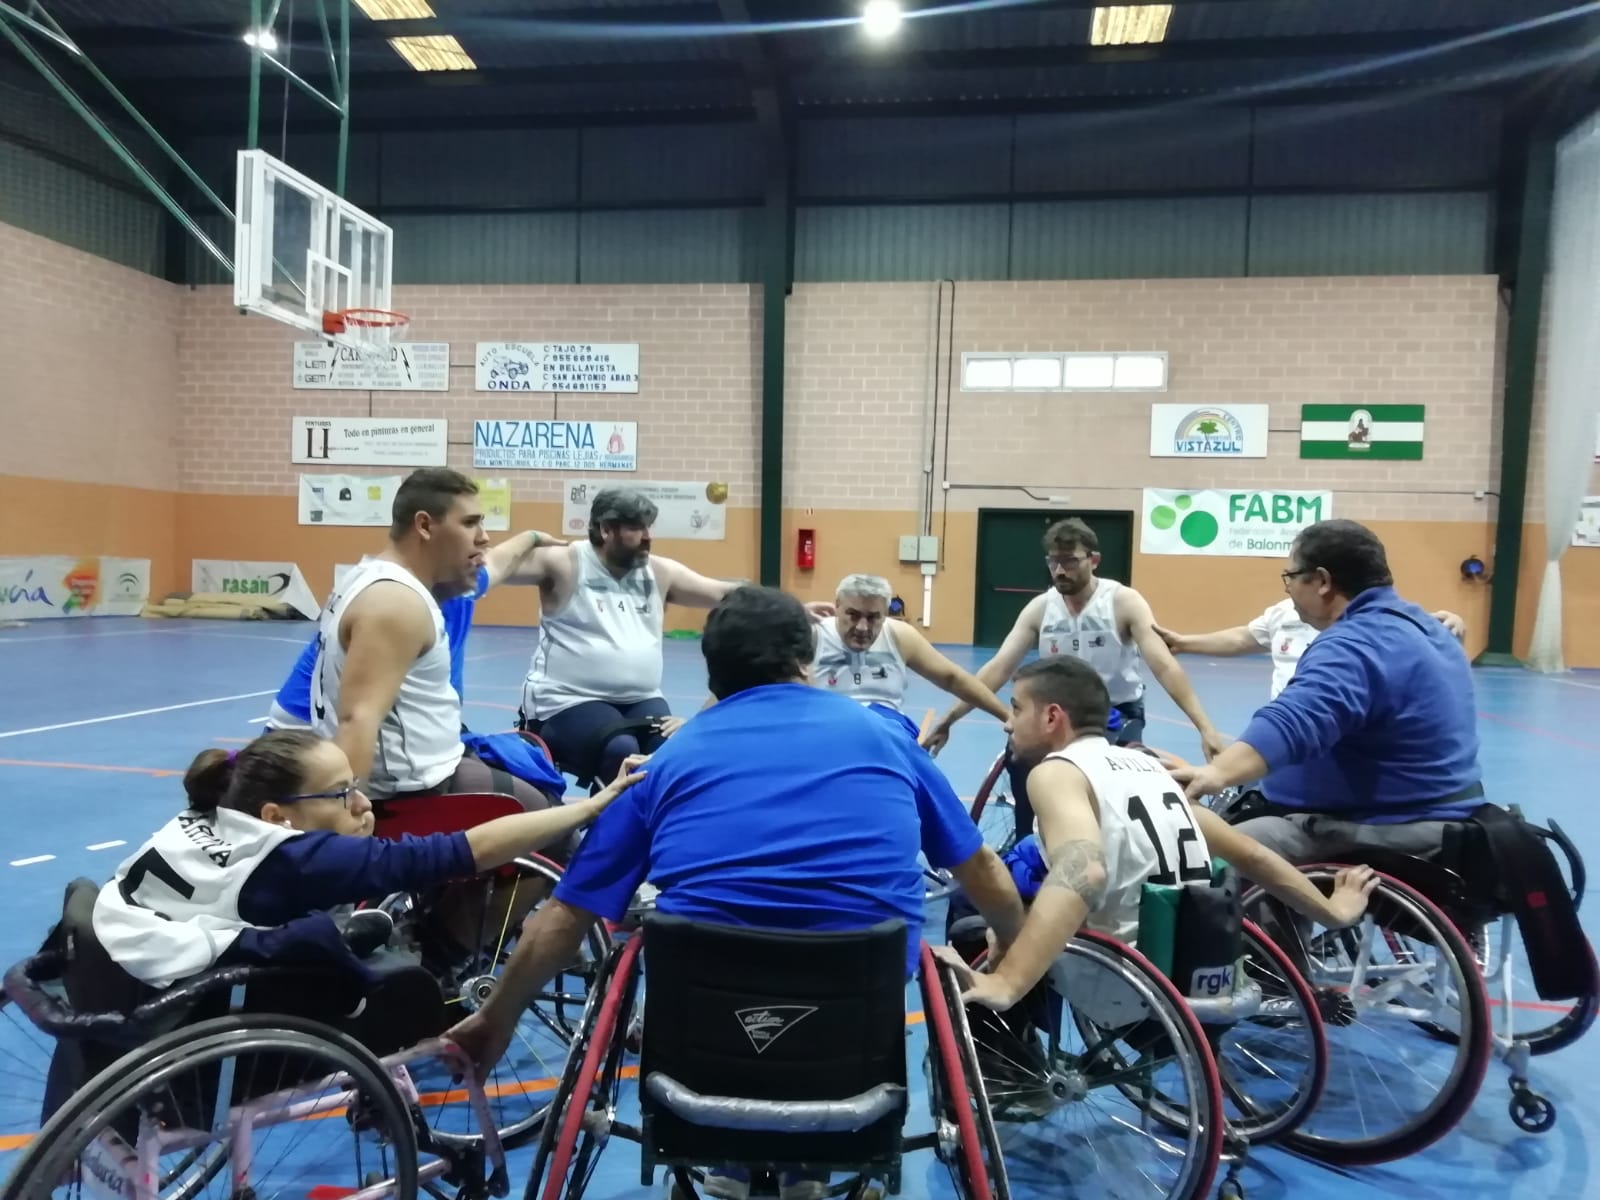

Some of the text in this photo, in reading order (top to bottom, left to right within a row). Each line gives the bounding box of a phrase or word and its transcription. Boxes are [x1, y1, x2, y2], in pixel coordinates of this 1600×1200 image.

[504, 343, 540, 367] ESCUELA
[552, 345, 576, 353] TAJO
[543, 364, 616, 373] EN BELLAVISTA
[552, 373, 568, 381] SAN
[571, 374, 607, 382] ANTONIO
[487, 380, 531, 391] ONDA
[343, 423, 435, 439] Todo en pinturas en general
[475, 421, 596, 449] NAZARENA
[1176, 441, 1241, 453] VISTAZUL
[475, 448, 517, 460] PRODUCTOS
[518, 449, 536, 460] PARA
[538, 449, 571, 460] PISCINAS
[599, 461, 634, 469] HERMANAS
[1229, 494, 1322, 524] FABM
[1228, 539, 1244, 550] de
[617, 600, 626, 613] 4
[1072, 639, 1080, 651] 9
[853, 672, 862, 685] 8
[1127, 791, 1212, 886] 12
[1197, 967, 1232, 995] rgk
